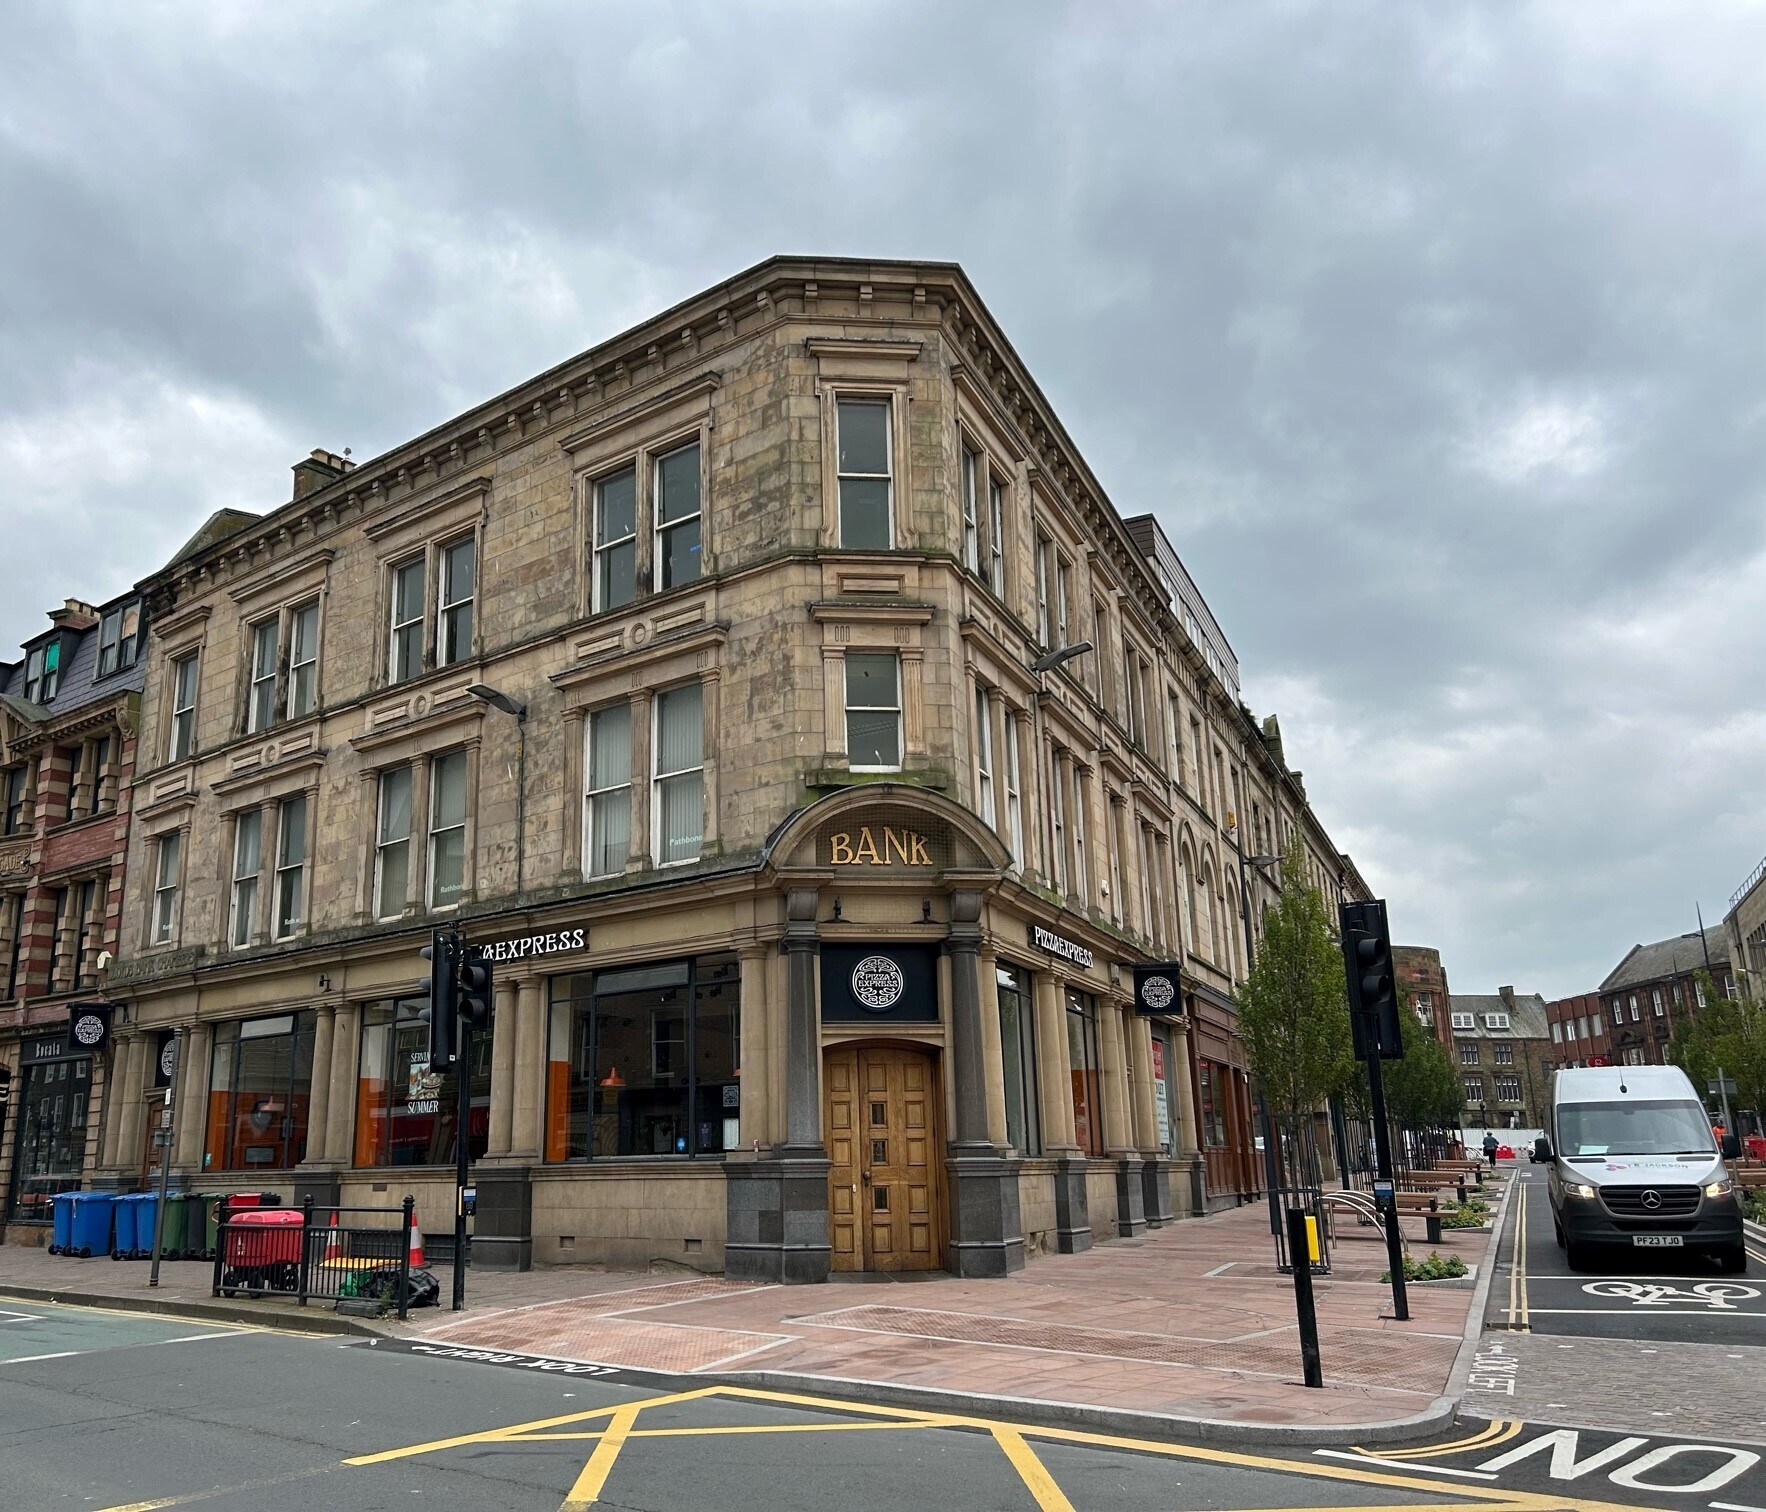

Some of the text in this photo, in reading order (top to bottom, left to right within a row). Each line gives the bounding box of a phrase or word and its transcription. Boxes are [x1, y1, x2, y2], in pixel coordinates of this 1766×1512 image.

[830, 826, 933, 865] BANK
[408, 1100, 439, 1114] SUMMER
[1636, 1236, 1660, 1245] PF23
[516, 1359, 621, 1376] LOOK
[1474, 1429, 1762, 1493] NO
